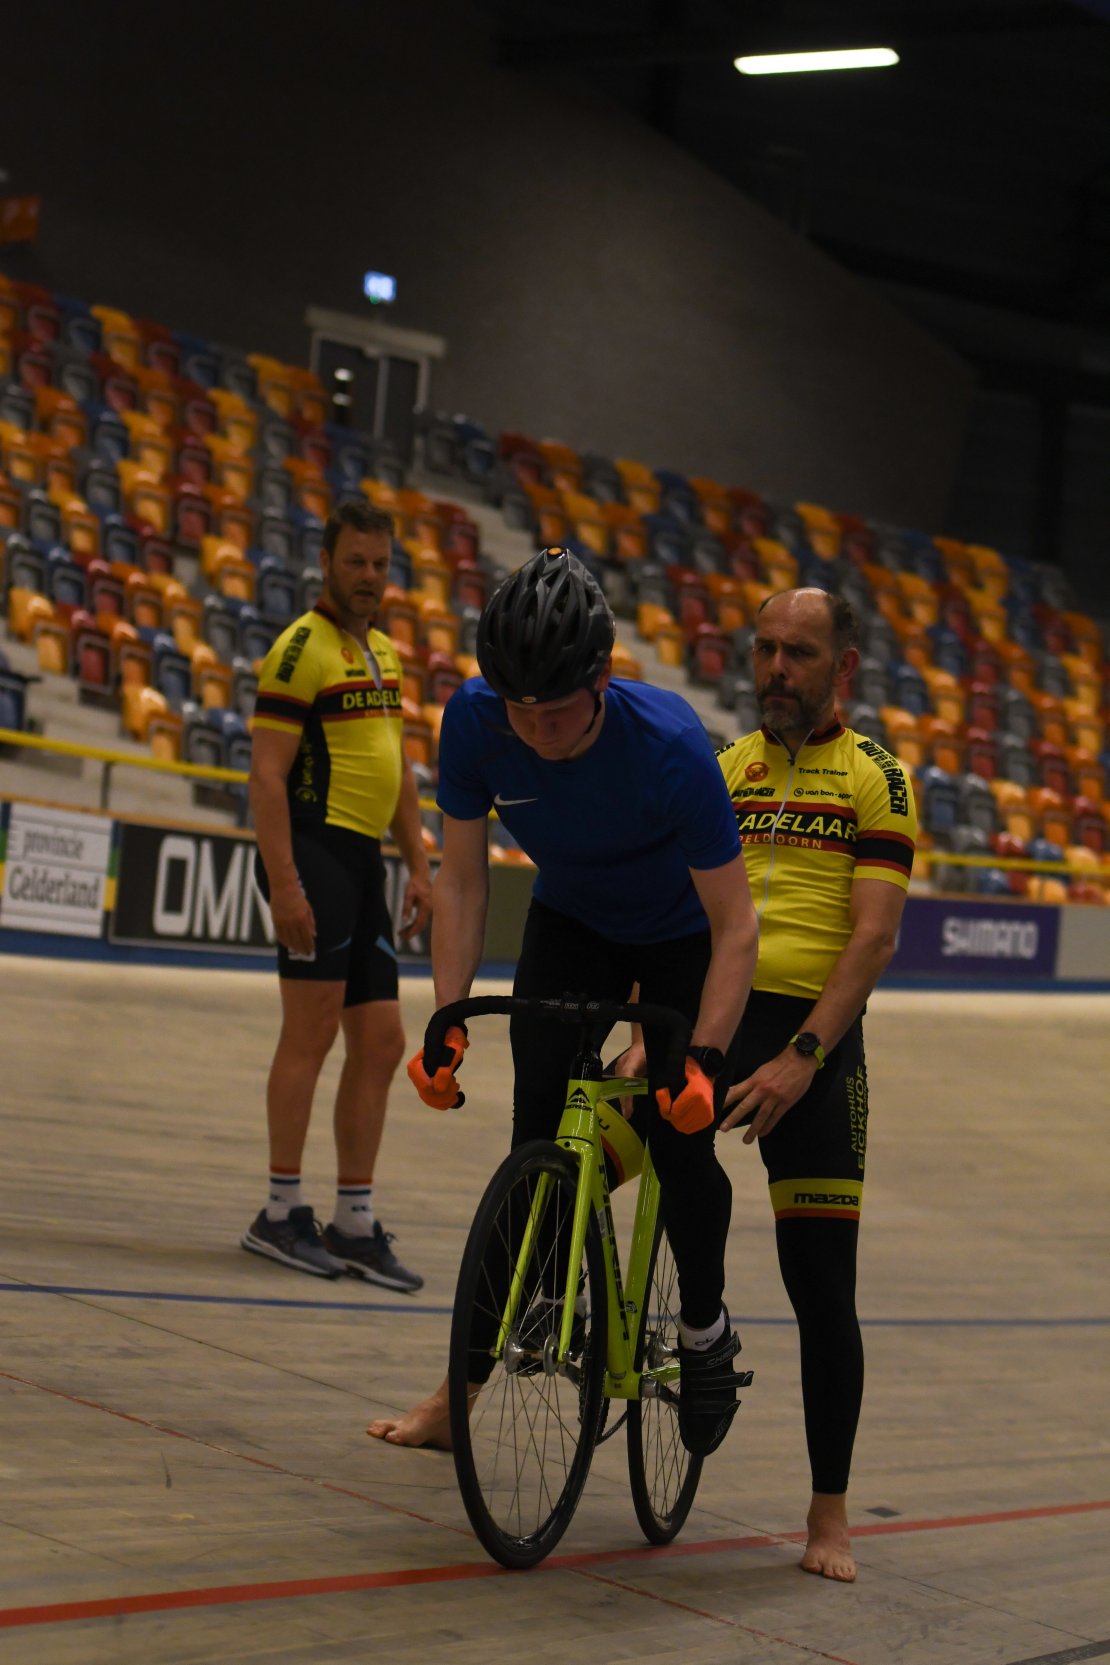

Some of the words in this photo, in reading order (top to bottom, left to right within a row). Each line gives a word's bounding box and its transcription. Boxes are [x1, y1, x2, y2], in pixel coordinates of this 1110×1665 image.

[342, 691, 366, 711] DE
[798, 767, 820, 775] Track
[822, 768, 849, 777] Trainer
[739, 812, 857, 842] ADELAAR
[9, 866, 100, 909] Gelderland
[941, 916, 1039, 960] SHIMANO
[846, 1076, 858, 1152] AUTOHUIS
[855, 1065, 866, 1170] EICKHOF
[795, 1192, 859, 1206] mazda
